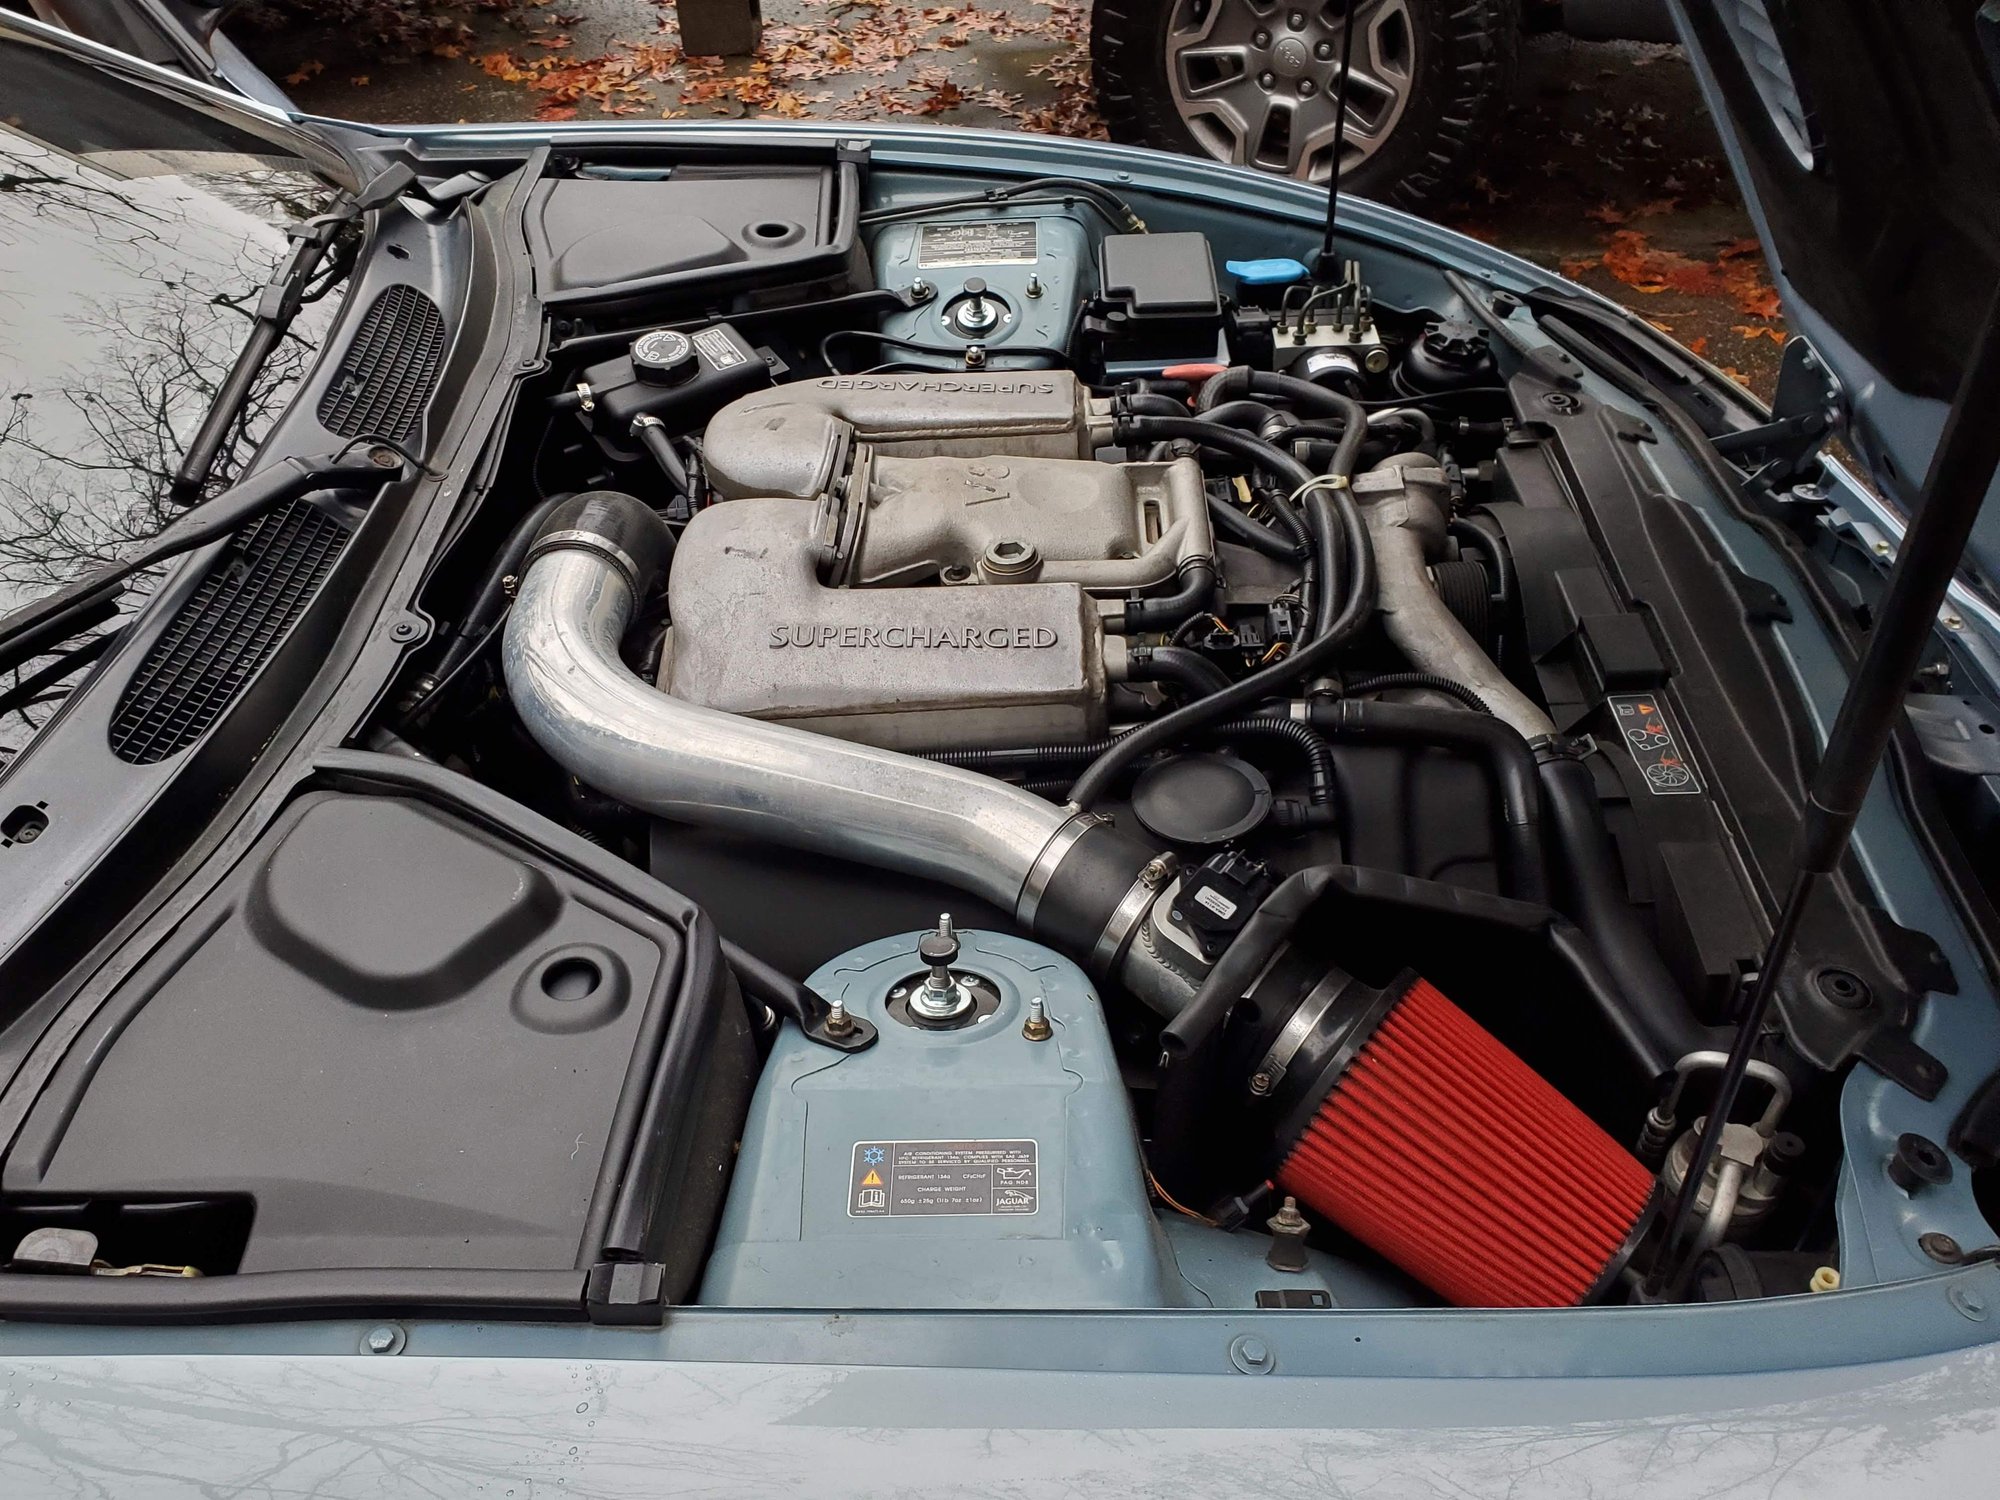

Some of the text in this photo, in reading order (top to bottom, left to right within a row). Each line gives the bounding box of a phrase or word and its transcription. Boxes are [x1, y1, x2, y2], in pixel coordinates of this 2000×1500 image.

[816, 378, 1054, 394] SUPERCHARGED
[964, 463, 1010, 506] V8
[769, 624, 1058, 650] SUPERCHARGED
[996, 1197, 1029, 1206] JAGUAR
